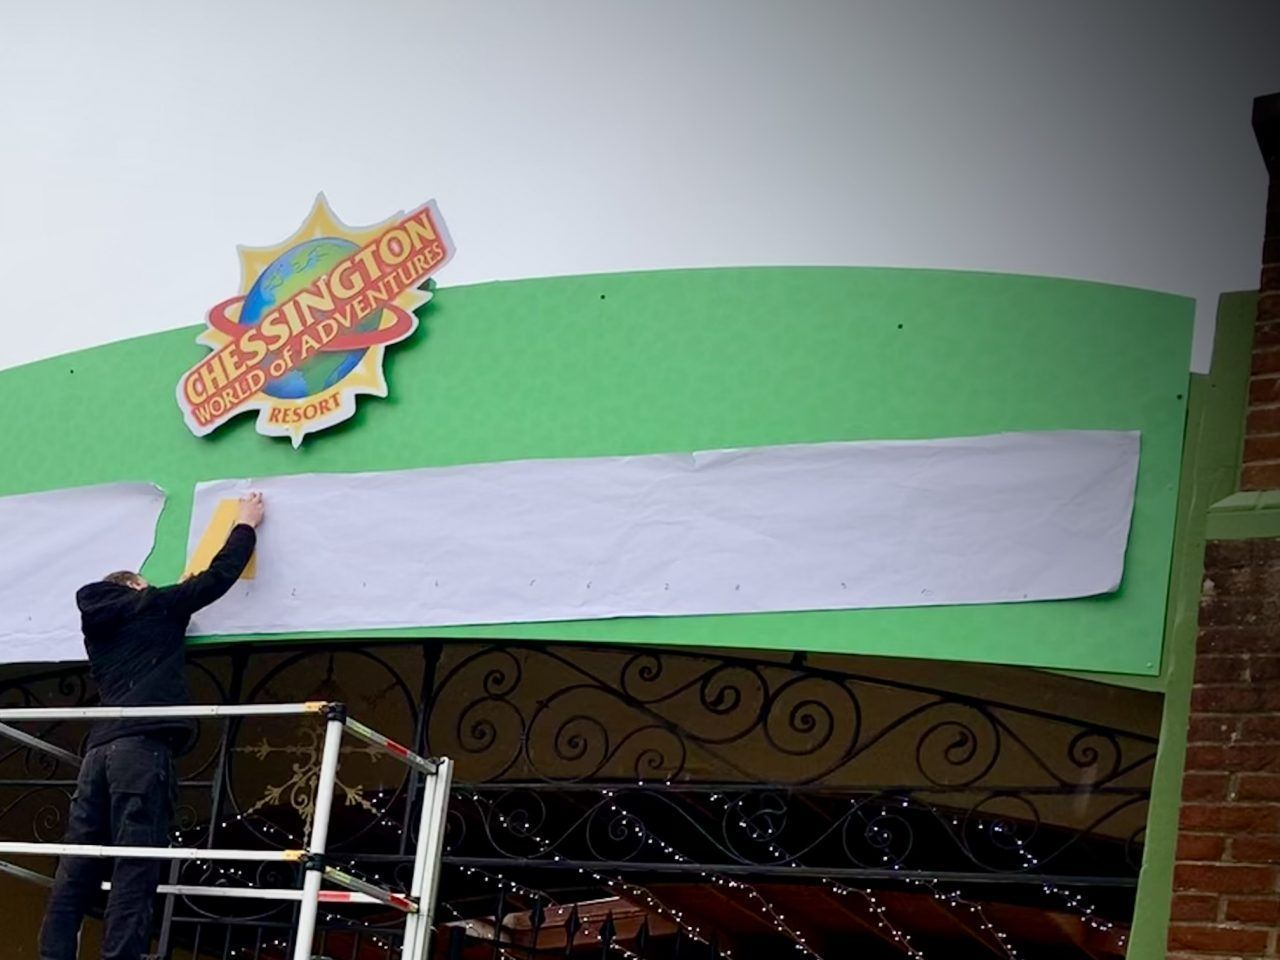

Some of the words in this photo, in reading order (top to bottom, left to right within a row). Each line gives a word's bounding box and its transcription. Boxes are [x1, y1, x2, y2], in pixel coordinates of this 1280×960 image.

[185, 211, 438, 405] CHESSINGTON
[194, 369, 266, 425] WORLD
[300, 242, 445, 360] ADVENTURES
[269, 391, 342, 424] RESORT
